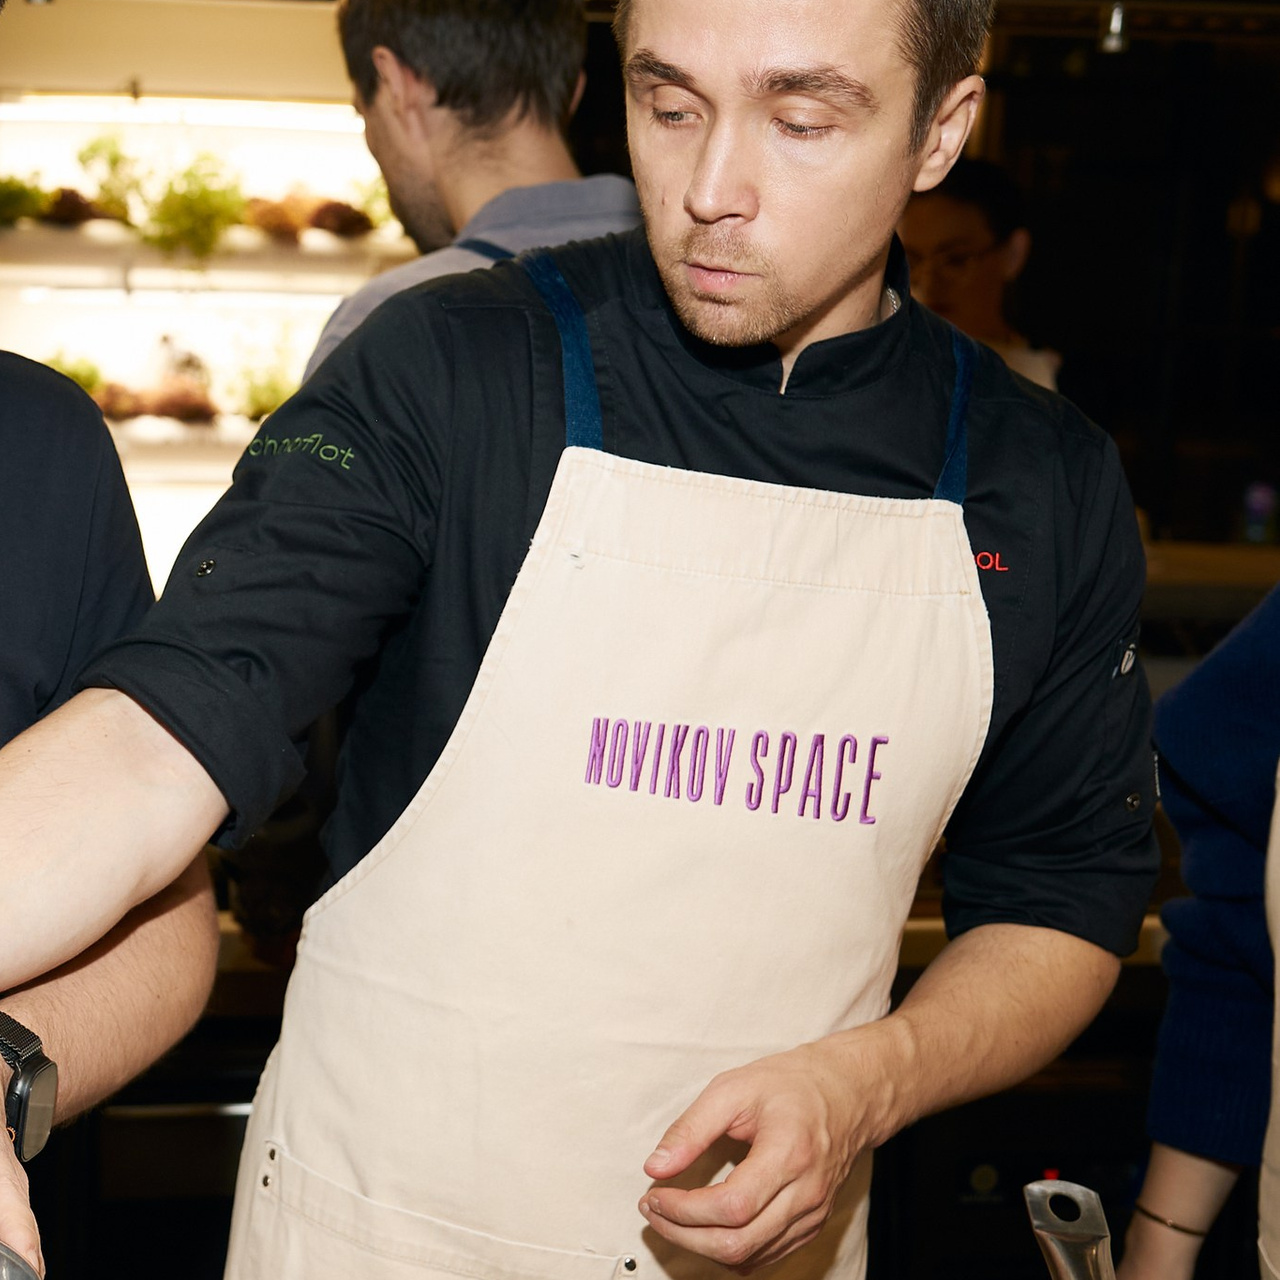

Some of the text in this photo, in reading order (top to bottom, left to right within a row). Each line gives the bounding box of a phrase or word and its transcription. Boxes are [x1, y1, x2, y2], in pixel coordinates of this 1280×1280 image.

[975, 551, 1009, 571] OL
[585, 717, 889, 825] NOVIKOV SPACE
